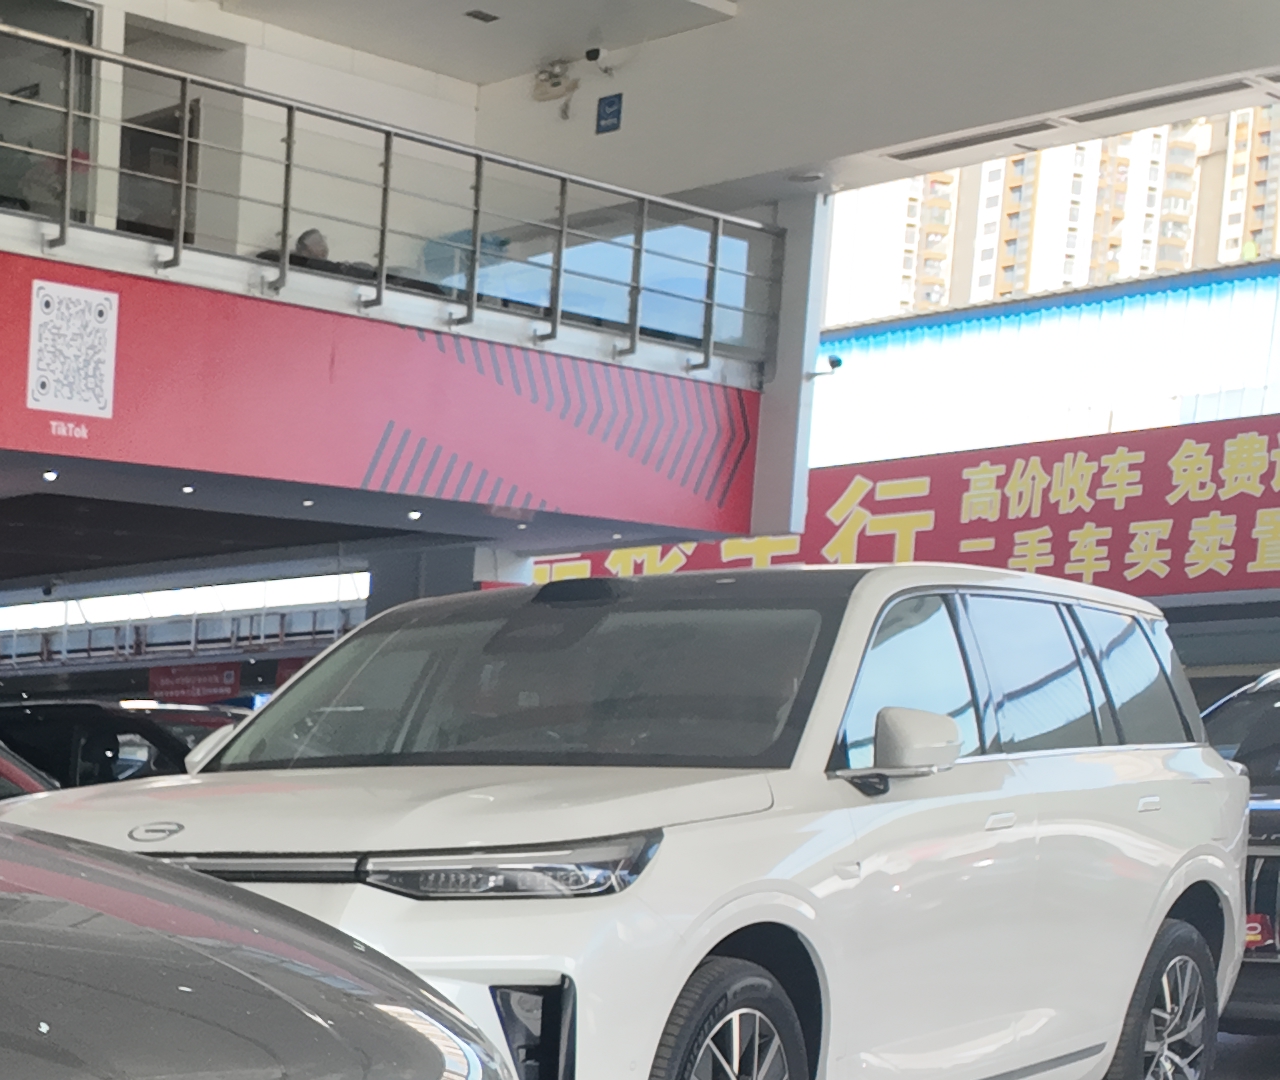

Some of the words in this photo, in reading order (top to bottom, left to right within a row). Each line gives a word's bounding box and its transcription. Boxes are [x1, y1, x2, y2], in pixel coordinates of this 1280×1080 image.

[49, 420, 89, 439] TikTok
[960, 446, 1146, 523] 高价收车
[1166, 431, 1280, 505] 免费
